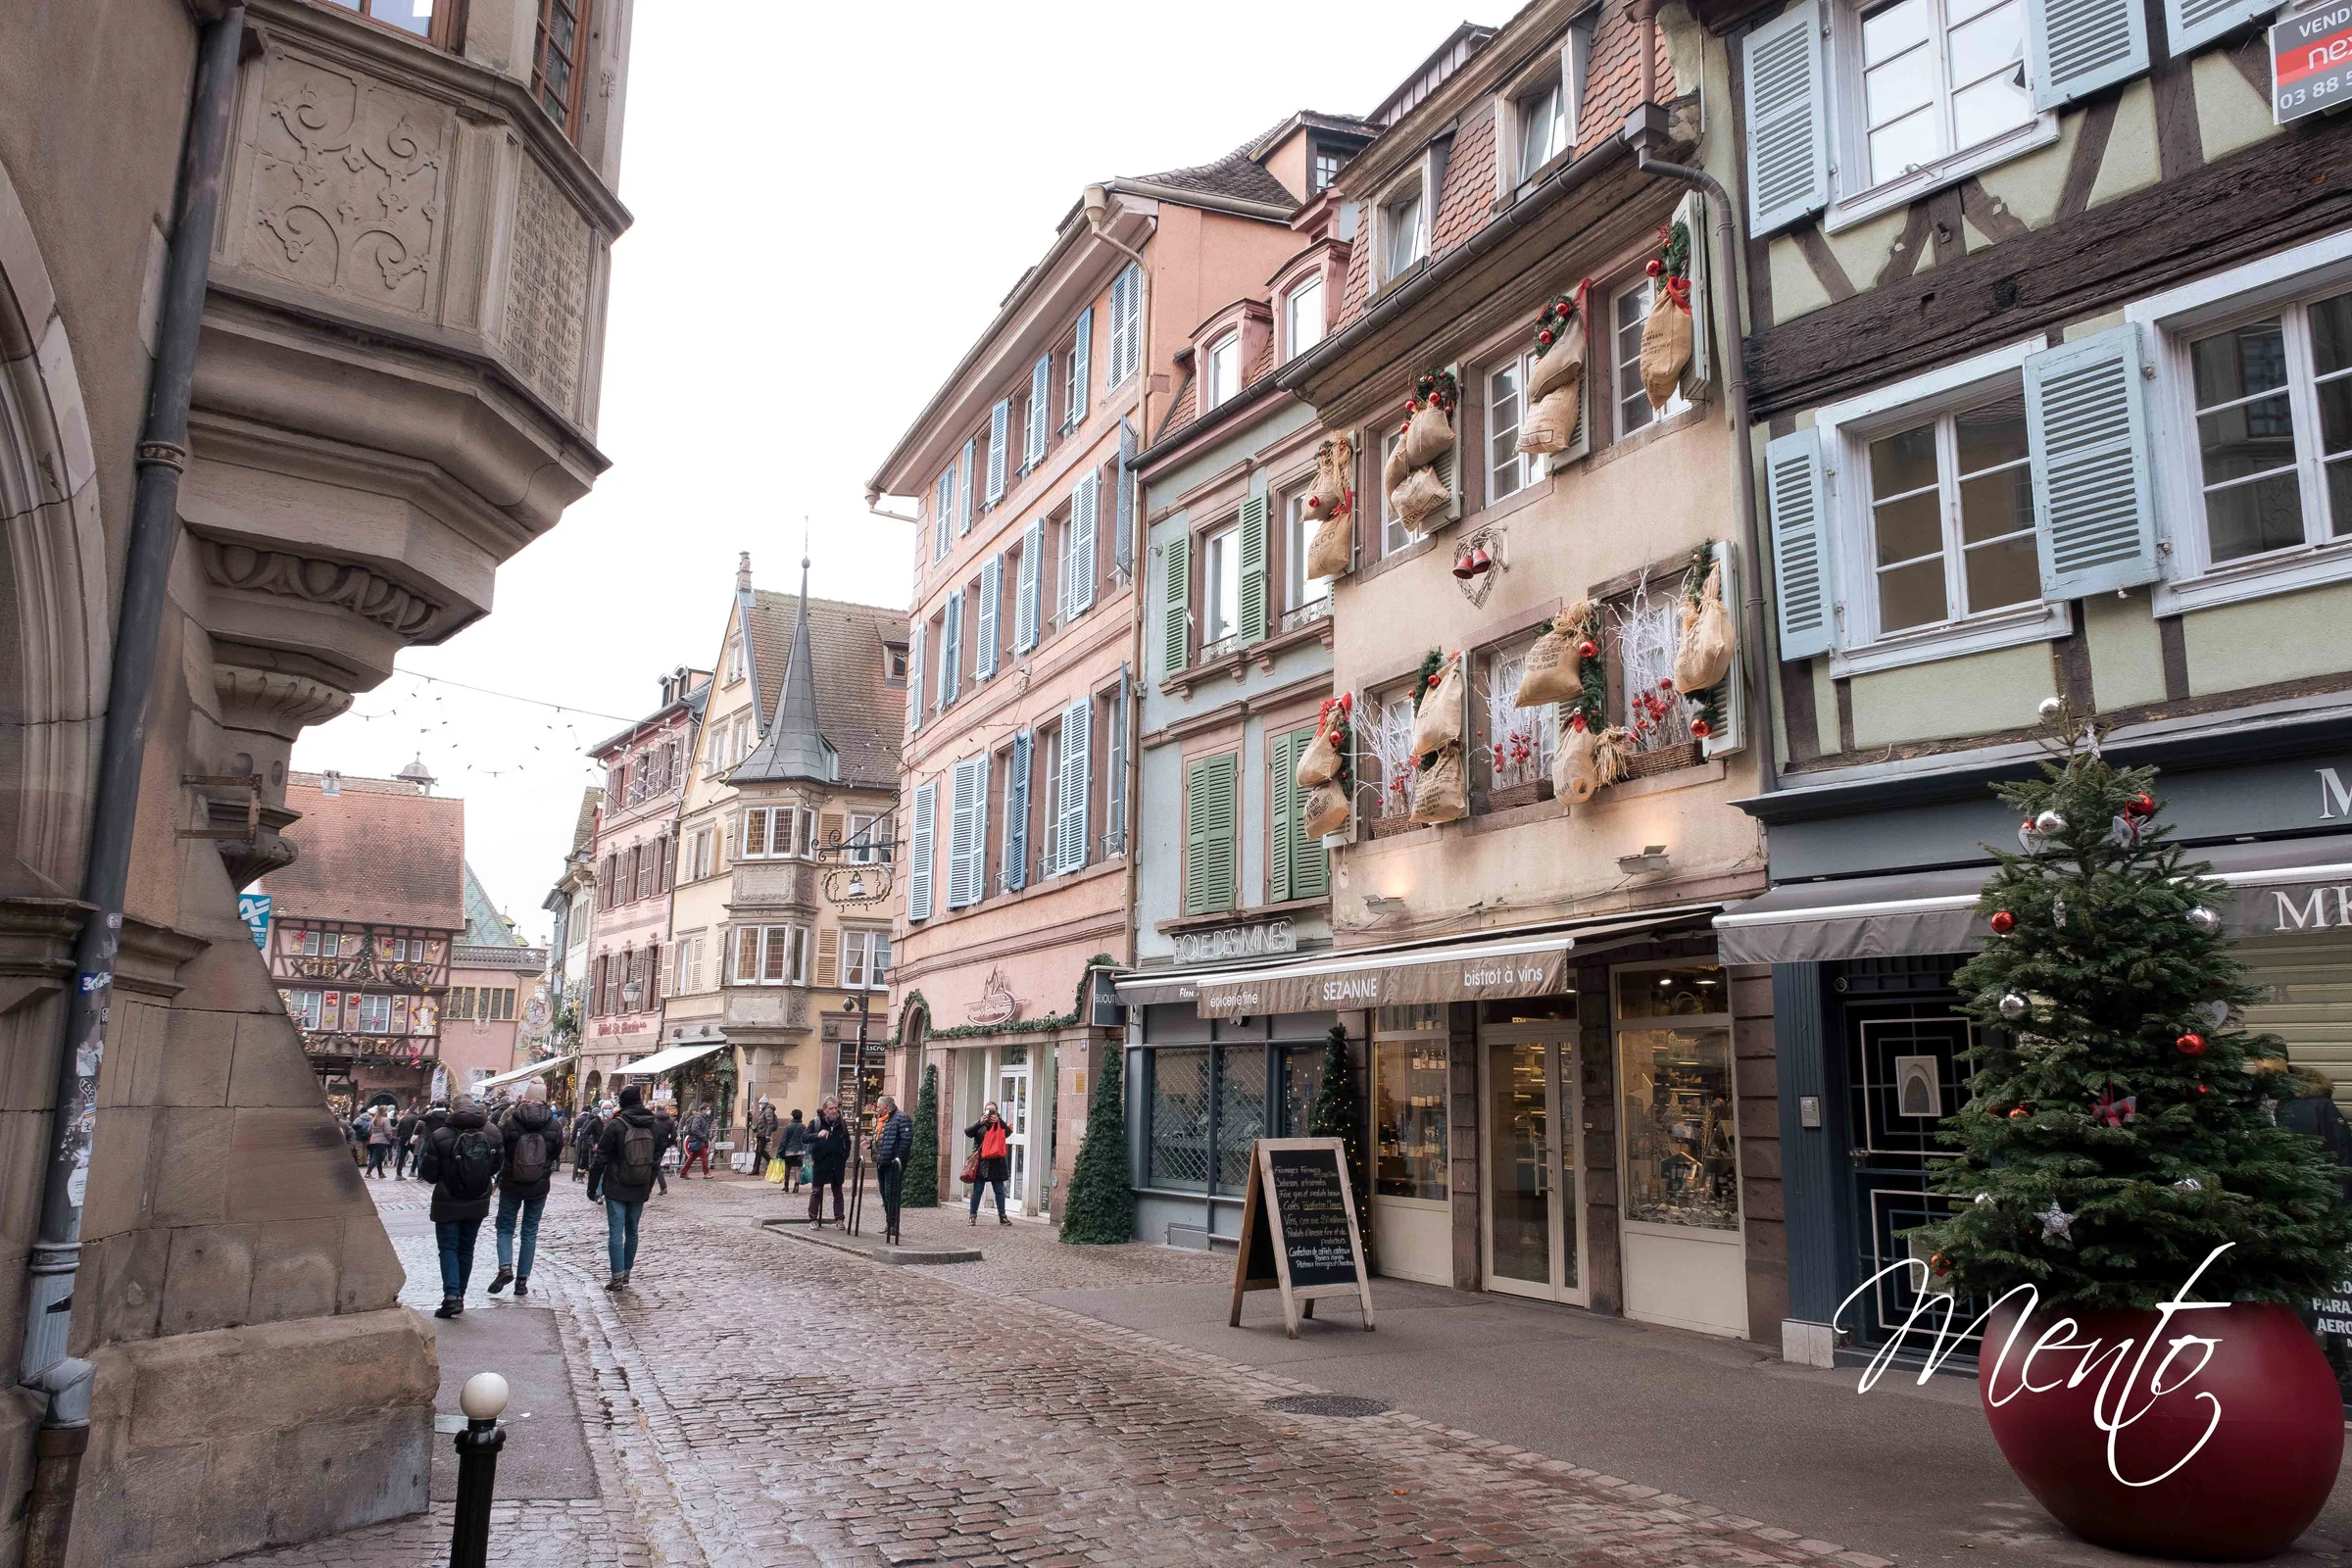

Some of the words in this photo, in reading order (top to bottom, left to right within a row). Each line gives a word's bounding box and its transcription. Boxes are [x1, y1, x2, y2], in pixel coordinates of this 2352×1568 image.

[2299, 5, 2352, 37] VEND
[2279, 88, 2306, 110] 03
[2313, 76, 2338, 98] 88
[1214, 928, 1239, 956] DES
[1242, 921, 1289, 952] MINES
[1464, 967, 1501, 986] bistrot
[1504, 964, 1513, 984] à
[1518, 964, 1544, 982] vins
[1209, 994, 1242, 1010] épicerie
[1243, 991, 1258, 1005] fine
[1323, 977, 1377, 1002] SEZANNE
[2313, 1298, 2352, 1315] PARA
